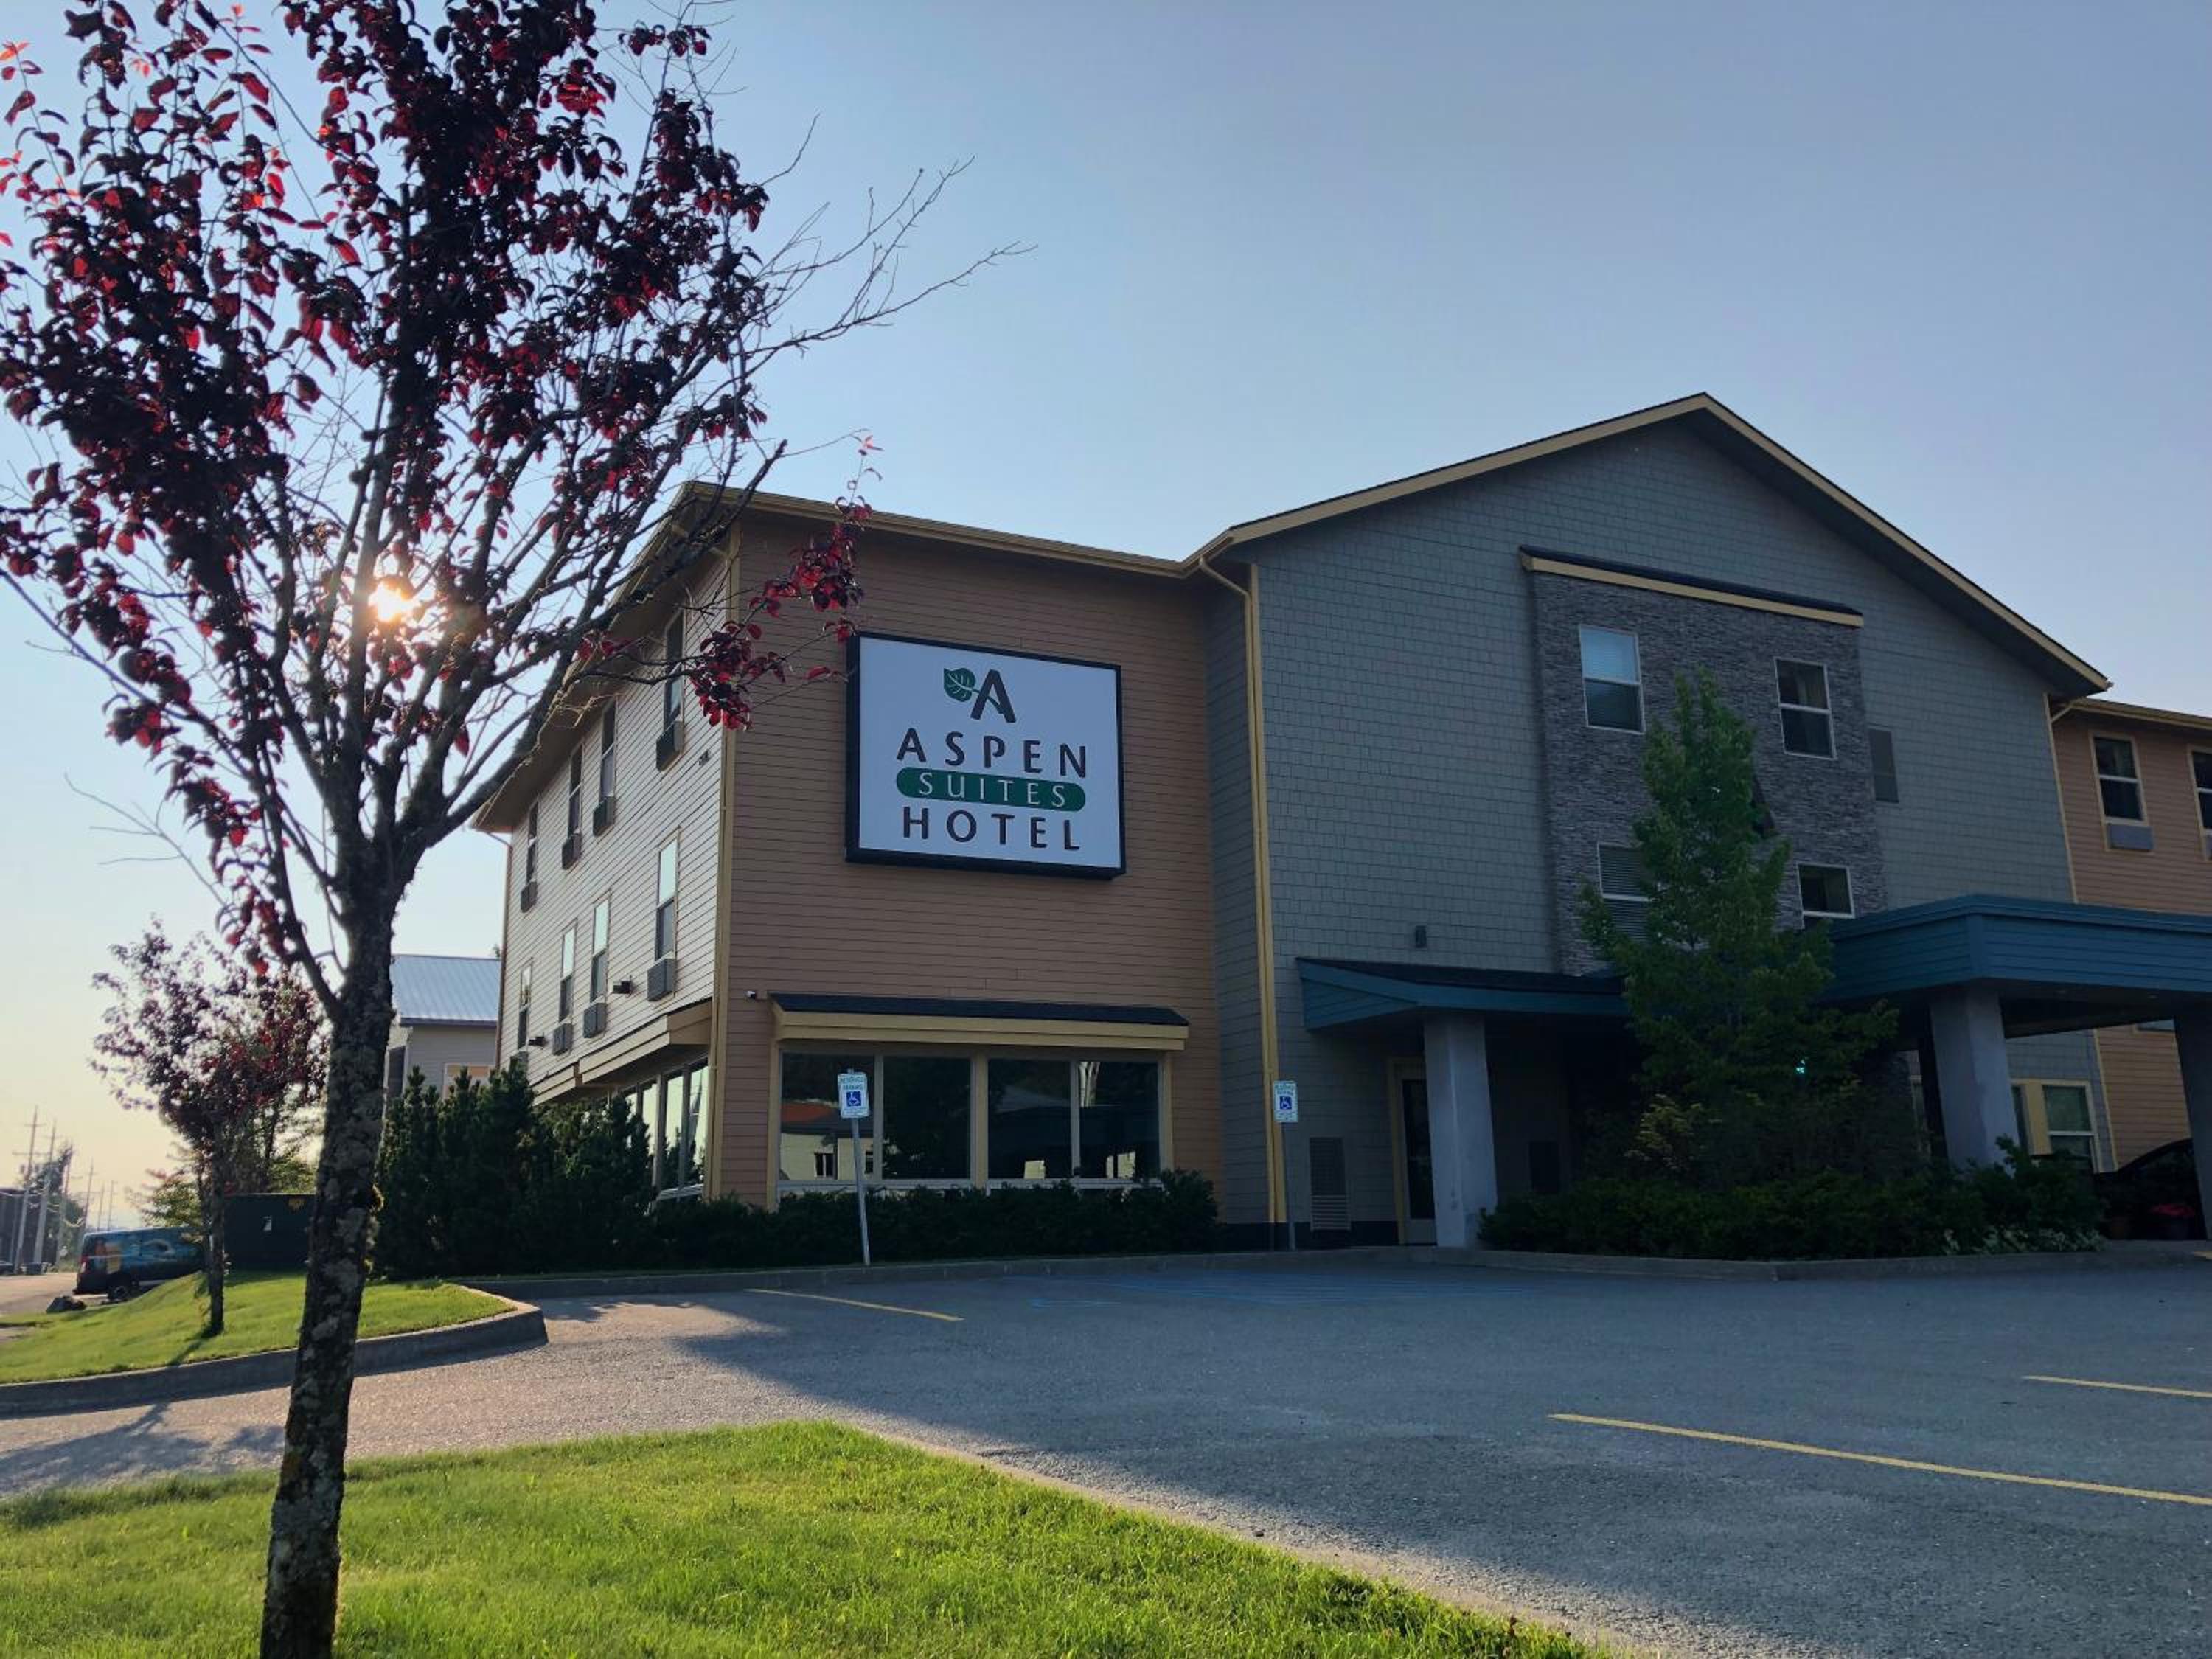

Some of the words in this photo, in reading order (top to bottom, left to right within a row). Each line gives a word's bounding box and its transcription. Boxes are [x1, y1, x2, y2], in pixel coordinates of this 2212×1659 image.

[970, 669, 1016, 723] A
[897, 728, 1086, 778] ASPEN
[919, 773, 1065, 807] SUITES
[903, 807, 1080, 850] HOTEL
